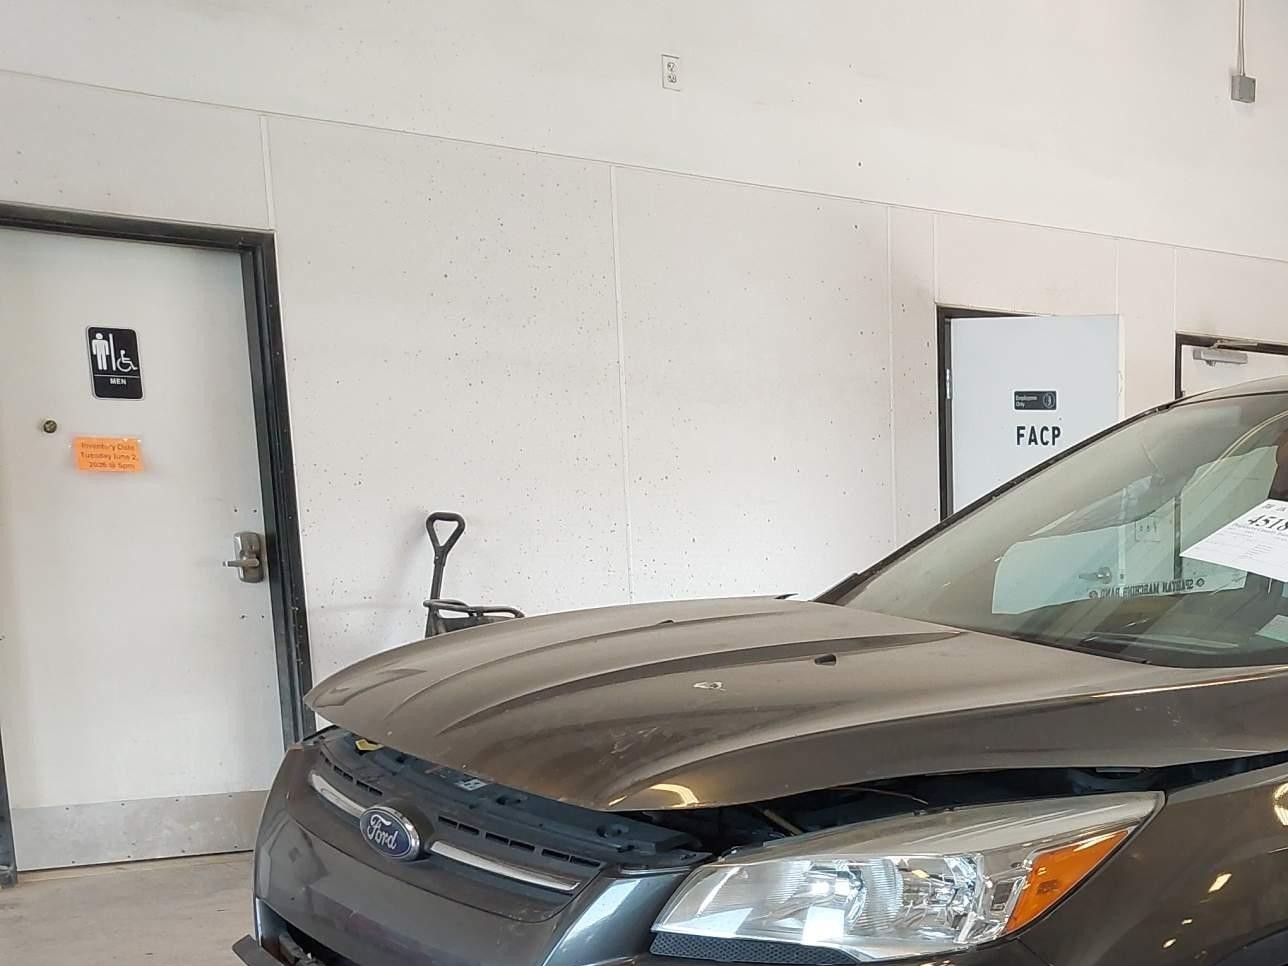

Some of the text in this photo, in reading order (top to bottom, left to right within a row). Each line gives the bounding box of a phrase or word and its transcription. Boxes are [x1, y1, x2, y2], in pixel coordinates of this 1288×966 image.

[109, 377, 127, 385] MEN
[1016, 425, 1061, 446] FACP
[366, 814, 398, 850] Ford
